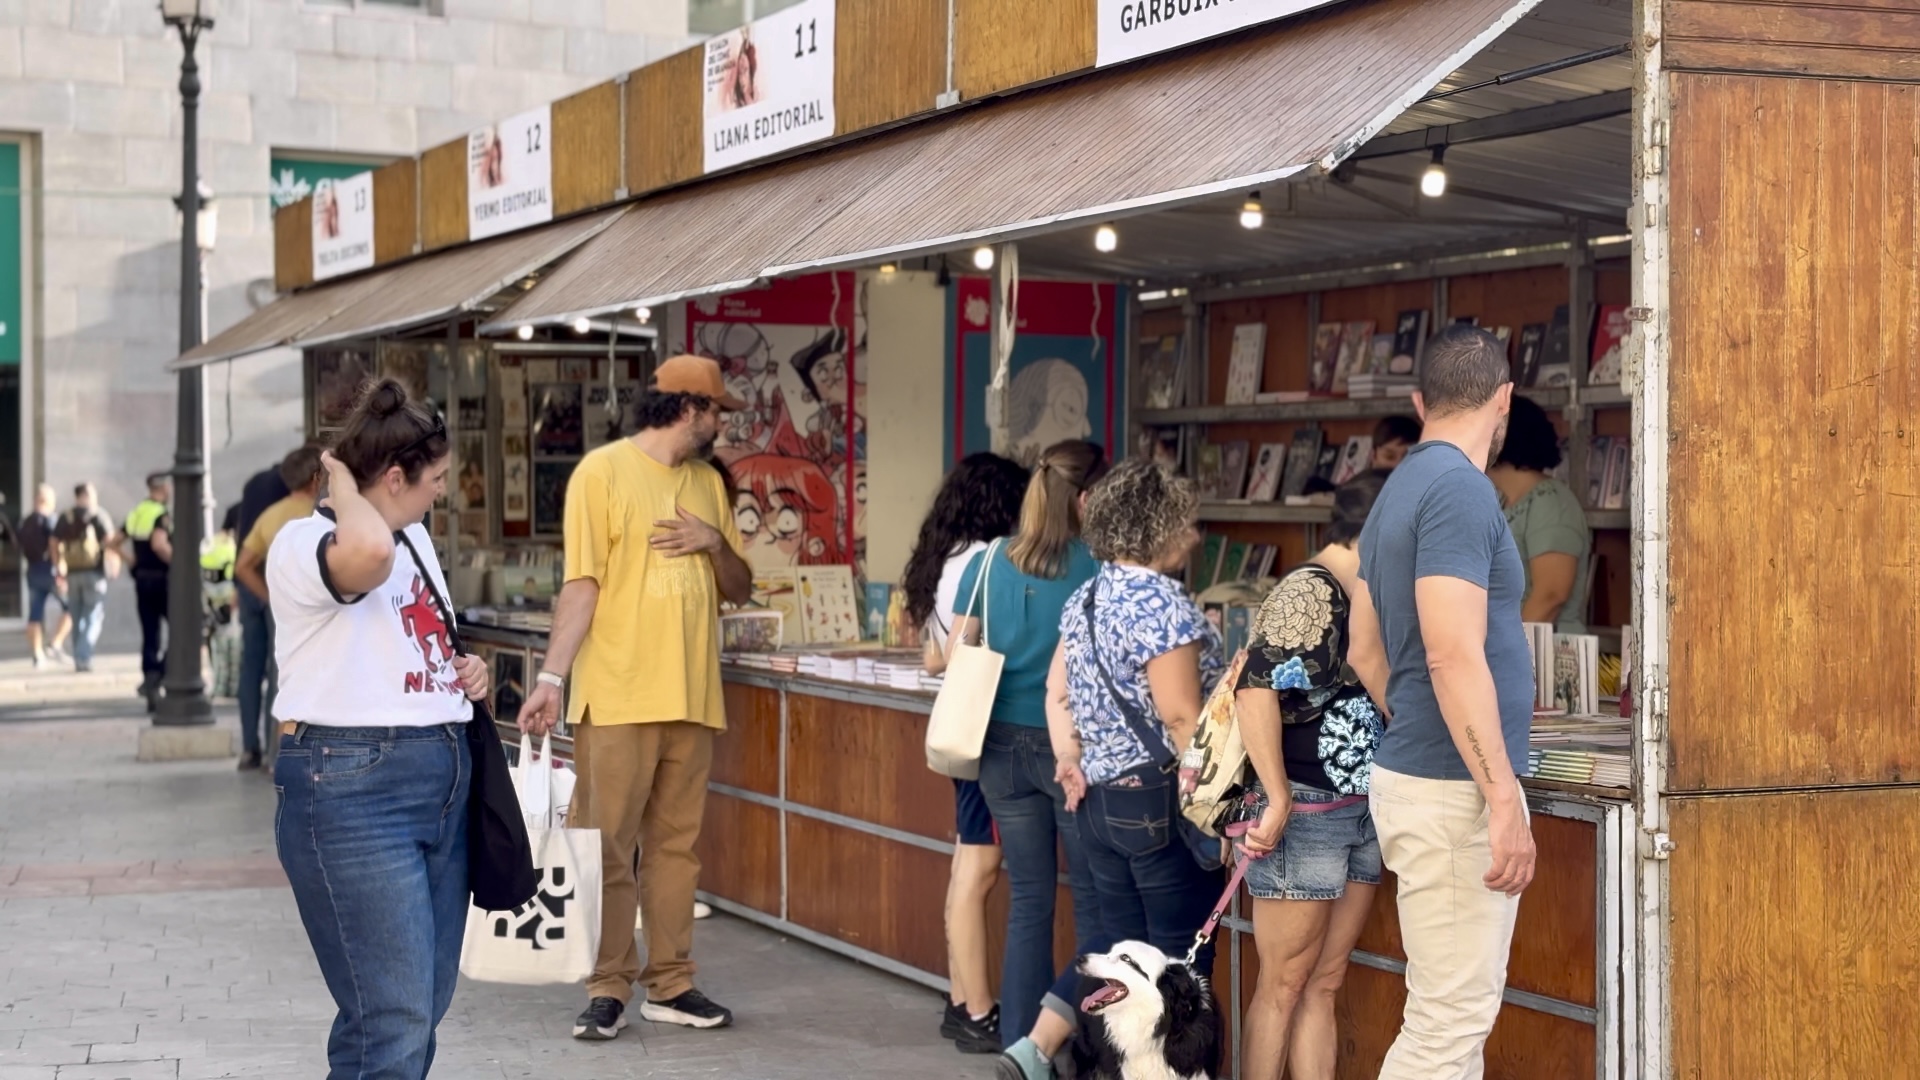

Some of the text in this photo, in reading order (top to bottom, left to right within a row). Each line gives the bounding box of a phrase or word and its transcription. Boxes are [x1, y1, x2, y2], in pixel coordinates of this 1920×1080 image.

[794, 18, 817, 59] 11
[526, 122, 541, 154] 12
[714, 99, 824, 153] LIANA EDITORIAL
[474, 187, 547, 221] YERMO EDITORIAL
